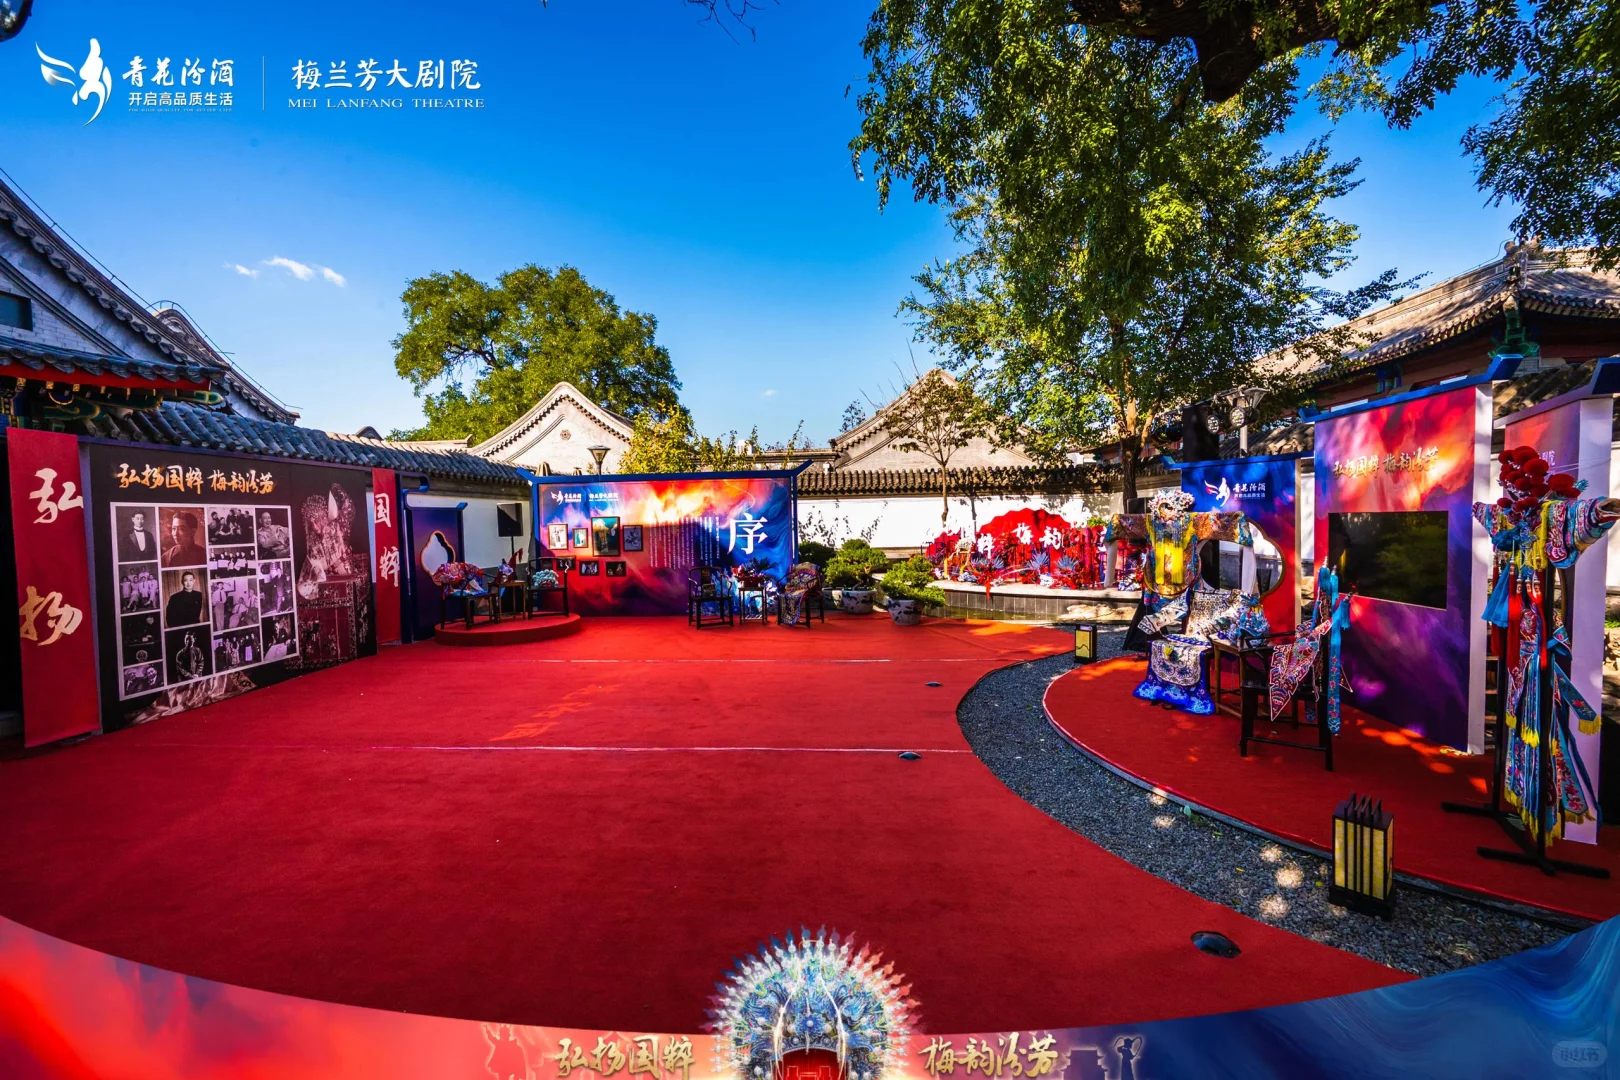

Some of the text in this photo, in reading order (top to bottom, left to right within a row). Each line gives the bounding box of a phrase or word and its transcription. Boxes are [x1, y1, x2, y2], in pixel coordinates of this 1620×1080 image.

[117, 463, 204, 495] 弘扬国粹
[727, 513, 768, 555] 序
